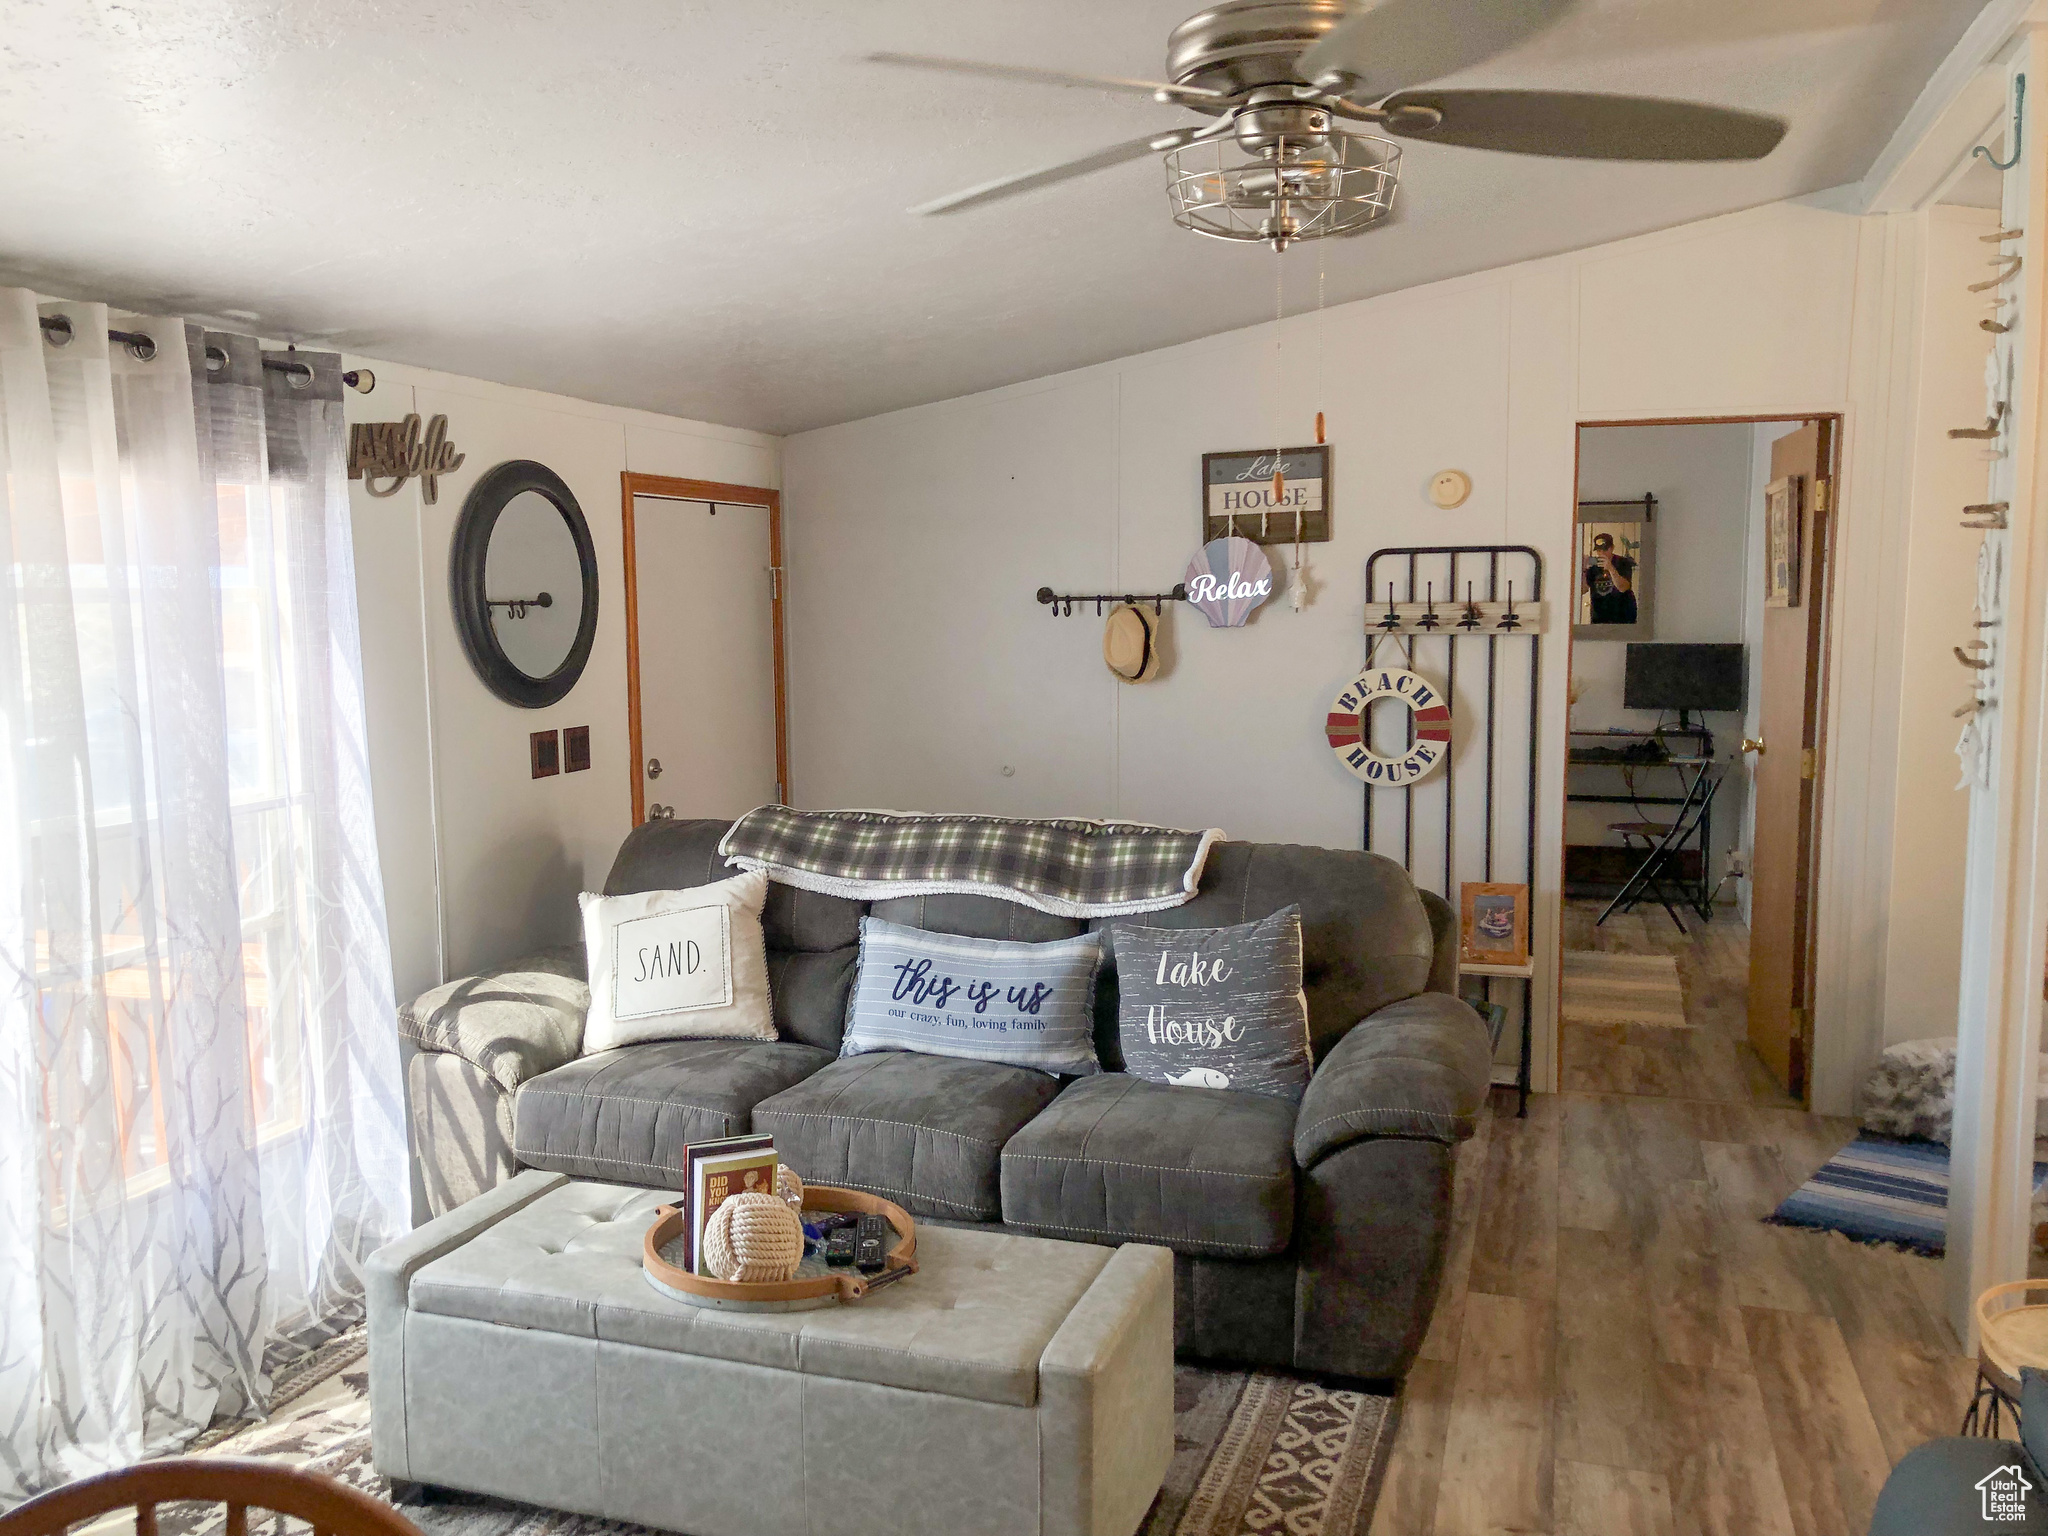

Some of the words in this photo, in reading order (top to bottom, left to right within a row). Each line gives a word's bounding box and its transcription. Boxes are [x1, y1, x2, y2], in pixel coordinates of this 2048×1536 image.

[1236, 456, 1291, 480] Lake
[1188, 571, 1272, 604] Relax
[1338, 672, 1434, 713] BEACH
[1346, 744, 1437, 782] HOUSE
[634, 940, 706, 982] SAND.
[1155, 950, 1234, 988] Lake
[891, 958, 960, 1009] this
[967, 979, 1001, 1013] is
[1007, 982, 1053, 1014] us
[888, 1008, 907, 1018] our
[910, 1011, 942, 1026] crazy,
[945, 1014, 968, 1030] fun,
[972, 1017, 1008, 1034] loving
[1012, 1019, 1048, 1034] family
[1147, 1004, 1246, 1049] House
[709, 1175, 729, 1188] DID
[709, 1187, 729, 1198] YOU
